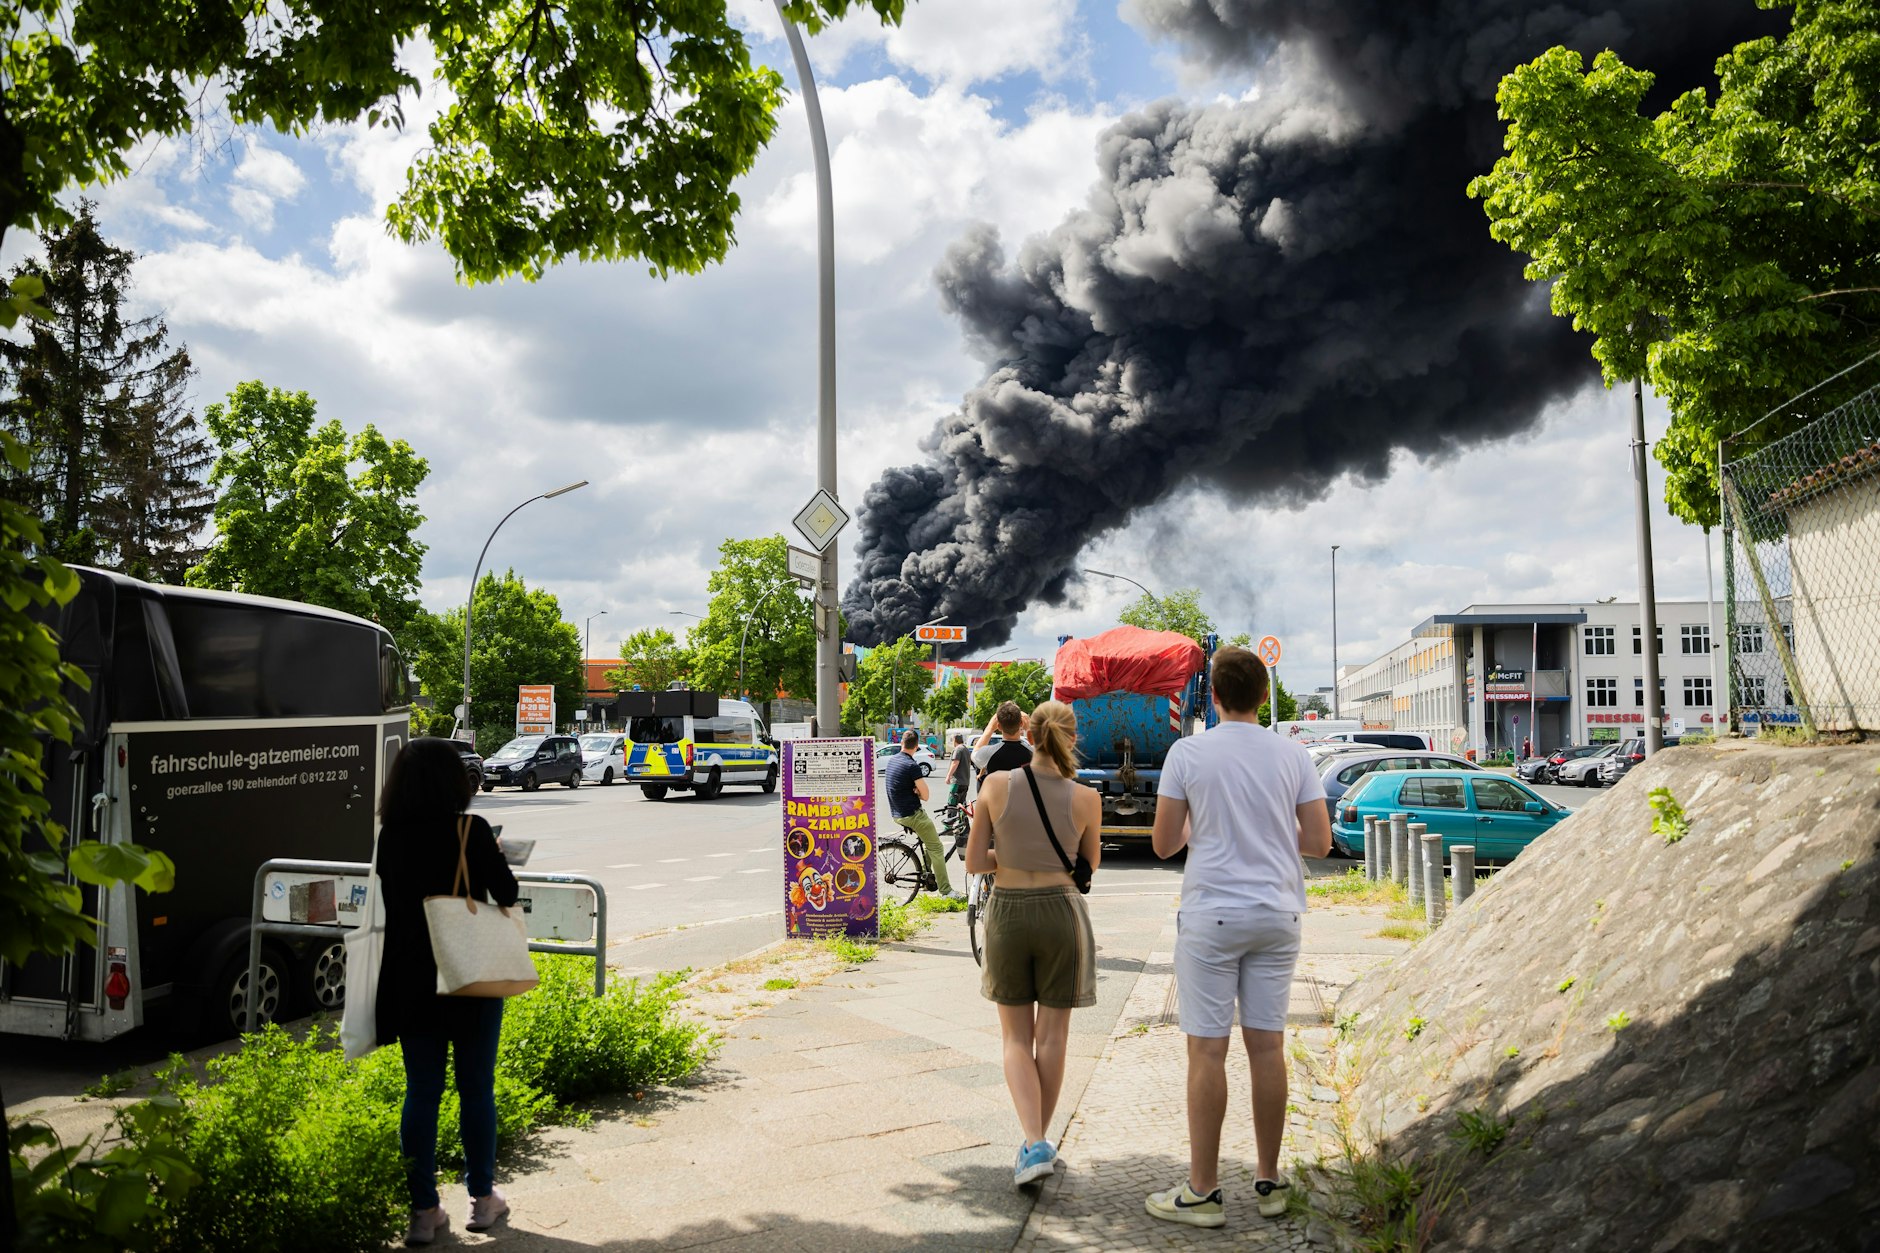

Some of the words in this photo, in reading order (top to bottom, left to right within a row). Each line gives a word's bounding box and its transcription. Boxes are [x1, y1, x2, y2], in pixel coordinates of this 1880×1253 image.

[919, 627, 964, 640] OBI
[1498, 672, 1522, 680] McFIT
[1586, 714, 1670, 724] FRESSNF
[523, 725, 545, 733] OBI
[150, 743, 360, 775] fahrschule-gatzemeier.com
[167, 781, 224, 800] goerzallee
[226, 778, 244, 792] 190
[246, 773, 298, 790] zehlendorf
[308, 771, 325, 784] 812
[326, 770, 337, 782] 22
[338, 769, 349, 781] 20
[787, 800, 844, 818] RAMBA
[807, 813, 870, 831] ZAMBA
